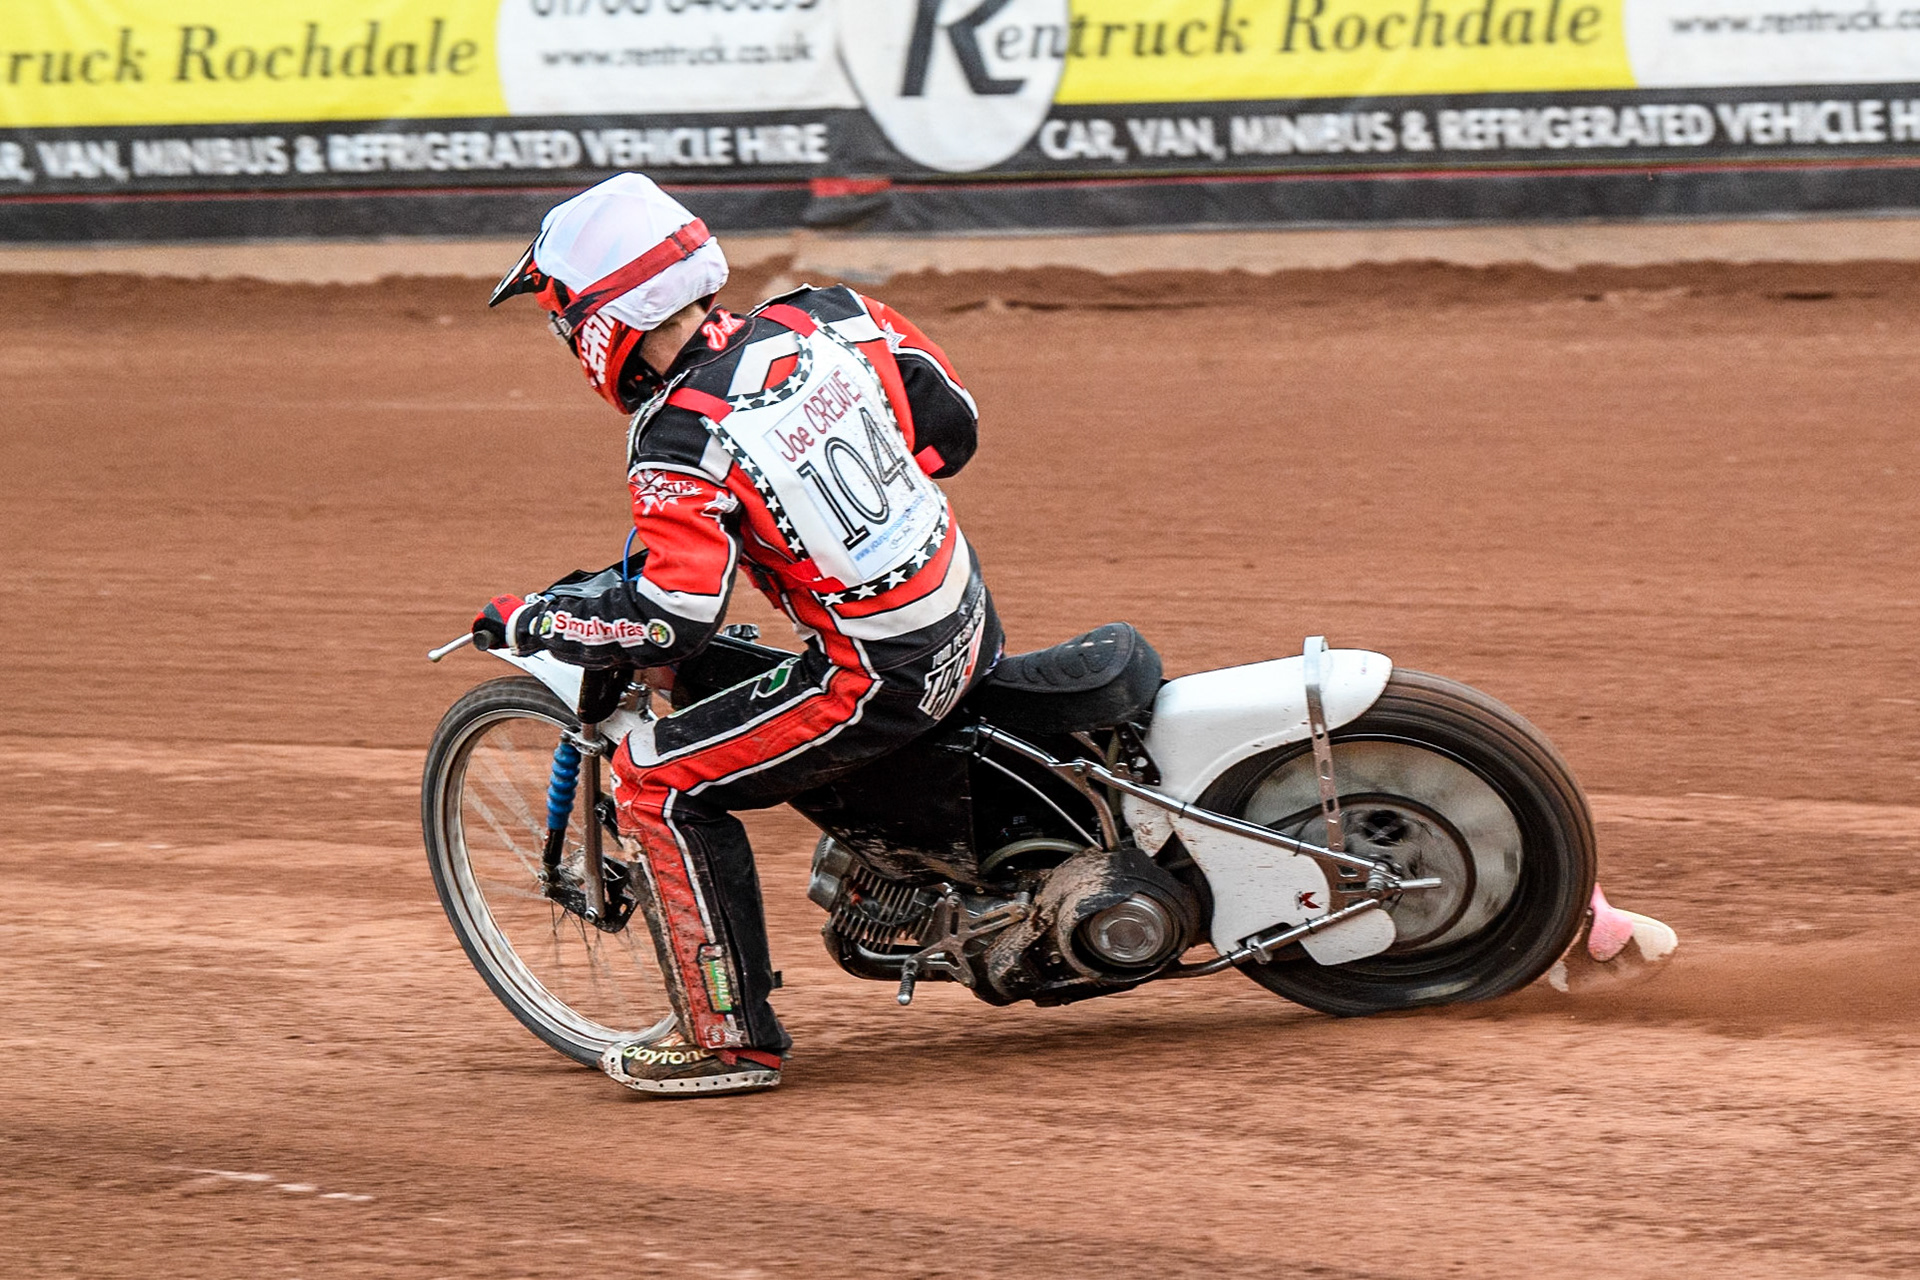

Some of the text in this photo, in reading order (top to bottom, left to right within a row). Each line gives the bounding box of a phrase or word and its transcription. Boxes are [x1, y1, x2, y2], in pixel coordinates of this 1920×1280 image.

[175, 19, 478, 82] Rochdale
[1280, 0, 1602, 53] Rochdale
[38, 141, 130, 184] VAN,
[131, 138, 288, 178] MINIBUS
[296, 138, 325, 173] &
[328, 132, 581, 172] REFRIGERATED
[583, 128, 733, 167] VEHICLE
[738, 123, 828, 163] HIRE
[1039, 119, 1127, 163] CAR,
[1127, 118, 1226, 162] VAN,
[1229, 113, 1397, 155] MINIBUS
[1401, 111, 1433, 151] &
[1438, 104, 1715, 150] REFRIGERATED
[1718, 100, 1886, 144] VEHICLE
[775, 370, 862, 462] Joe CREWE
[797, 407, 915, 550] 104
